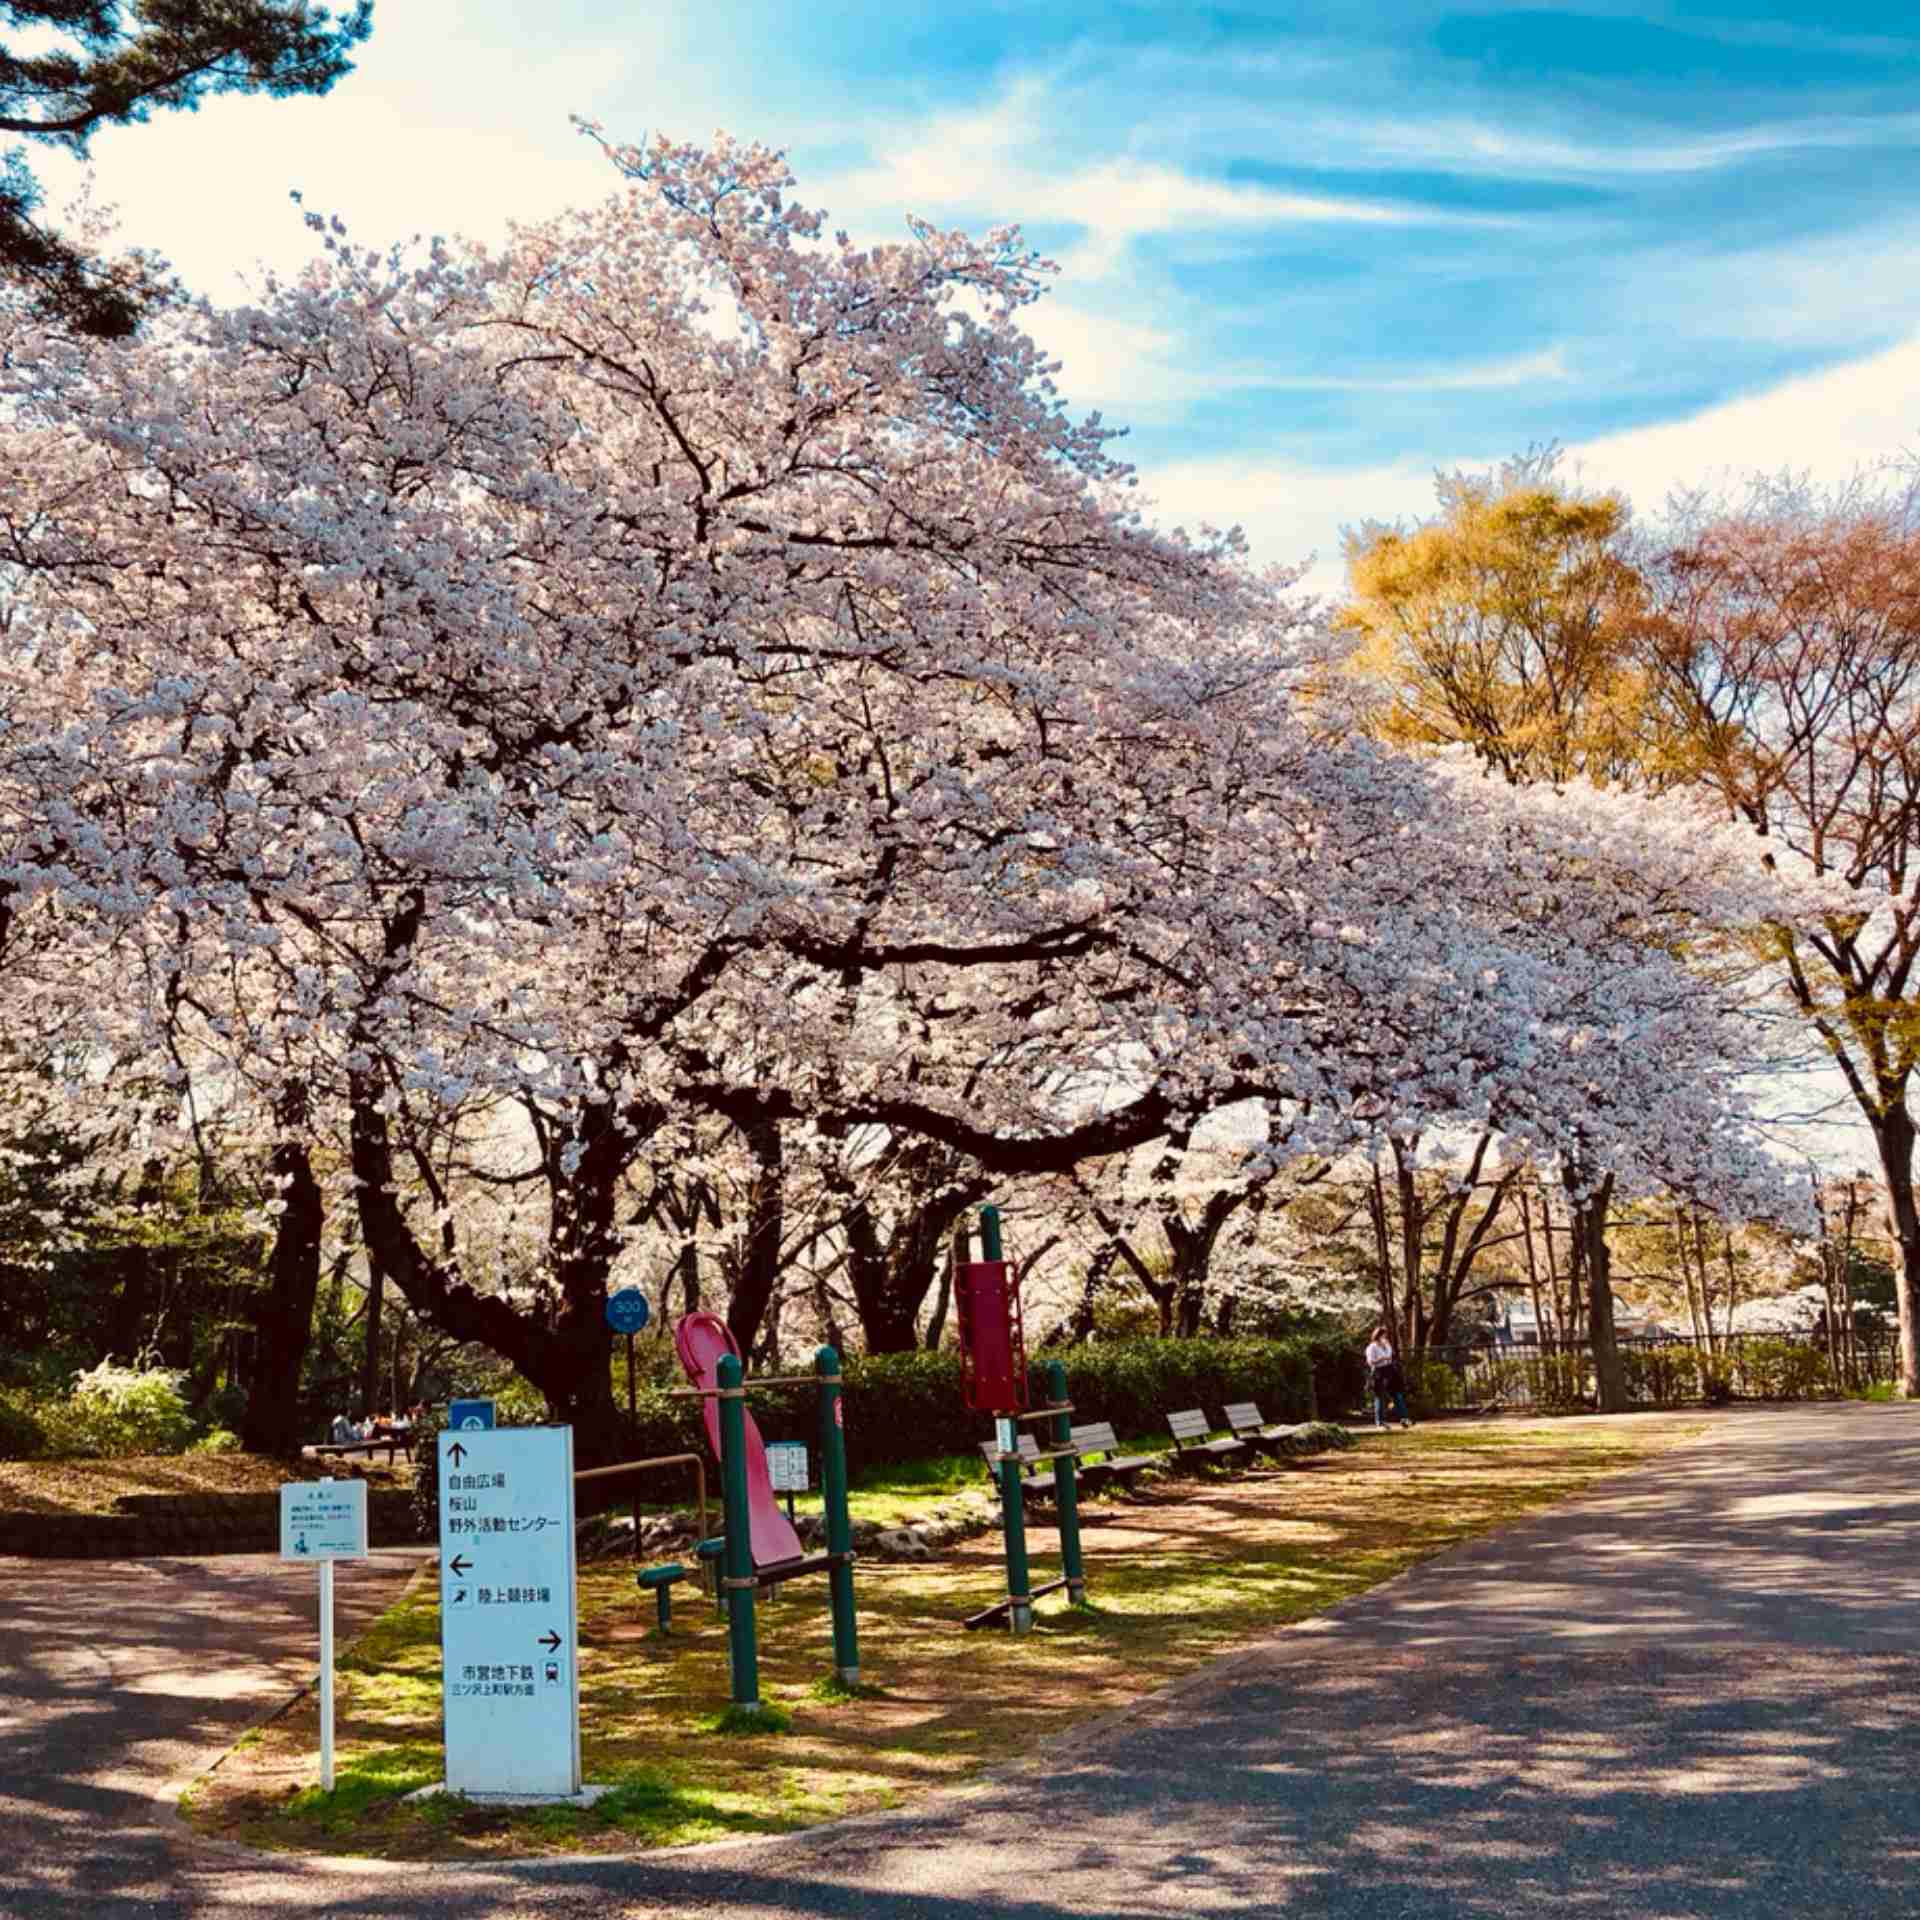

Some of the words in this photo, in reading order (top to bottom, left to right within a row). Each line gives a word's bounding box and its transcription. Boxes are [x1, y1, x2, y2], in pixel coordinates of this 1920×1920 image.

[449, 1474, 505, 1490] 自由広場
[449, 1497, 477, 1511] 桜山
[449, 1516, 560, 1533] 野外活動センター
[479, 1587, 550, 1604] 陸上競技場
[463, 1665, 534, 1680] 市営地下鉄
